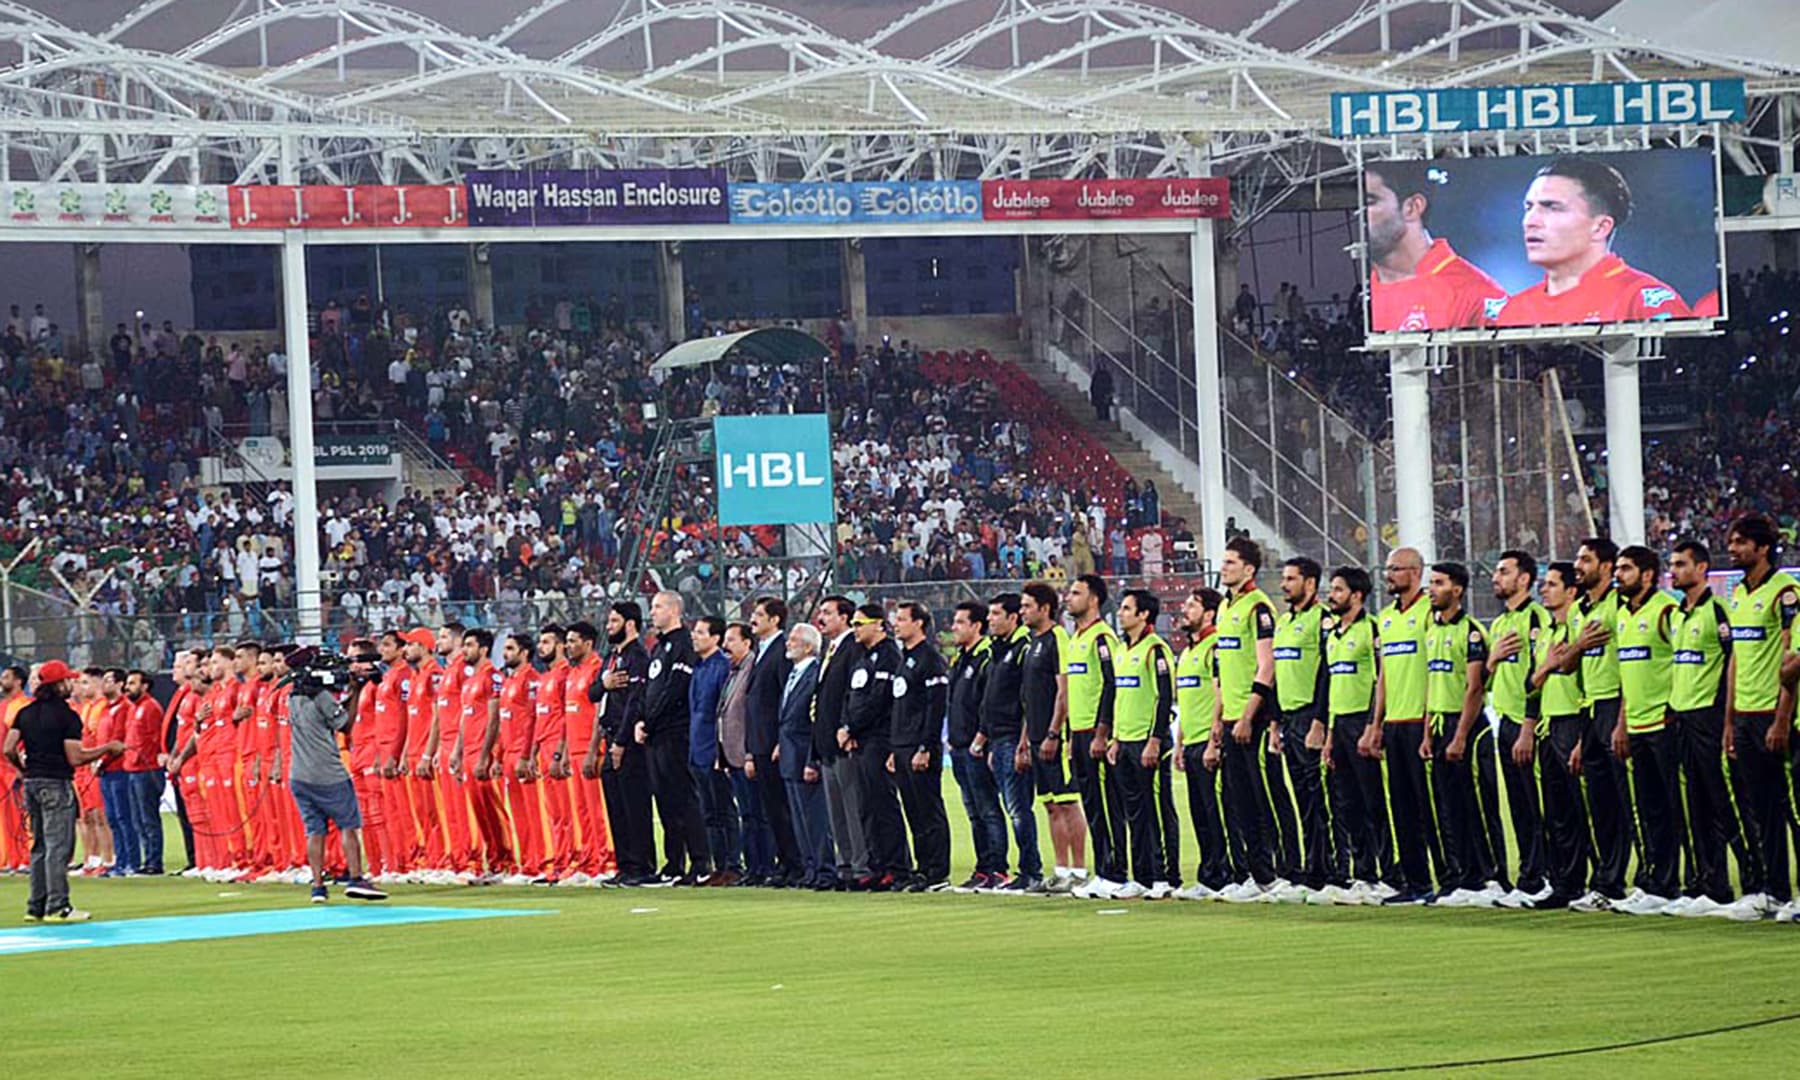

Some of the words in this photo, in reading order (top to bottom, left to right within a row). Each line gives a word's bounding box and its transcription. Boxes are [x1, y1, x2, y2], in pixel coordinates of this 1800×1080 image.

[1341, 94, 1461, 134] HBL
[1478, 87, 1597, 129] HBL
[1613, 81, 1735, 123] HBL
[472, 183, 538, 213] Waqar
[543, 182, 617, 207] Hassan
[623, 181, 721, 206] Enclosure
[992, 185, 1051, 208] Jubilee
[1077, 184, 1136, 207] Jubilee
[1161, 184, 1219, 206] Jubilee
[313, 446, 329, 456] BL
[331, 445, 356, 456] PSL
[358, 444, 389, 456] 2019
[722, 452, 825, 489] HBL
